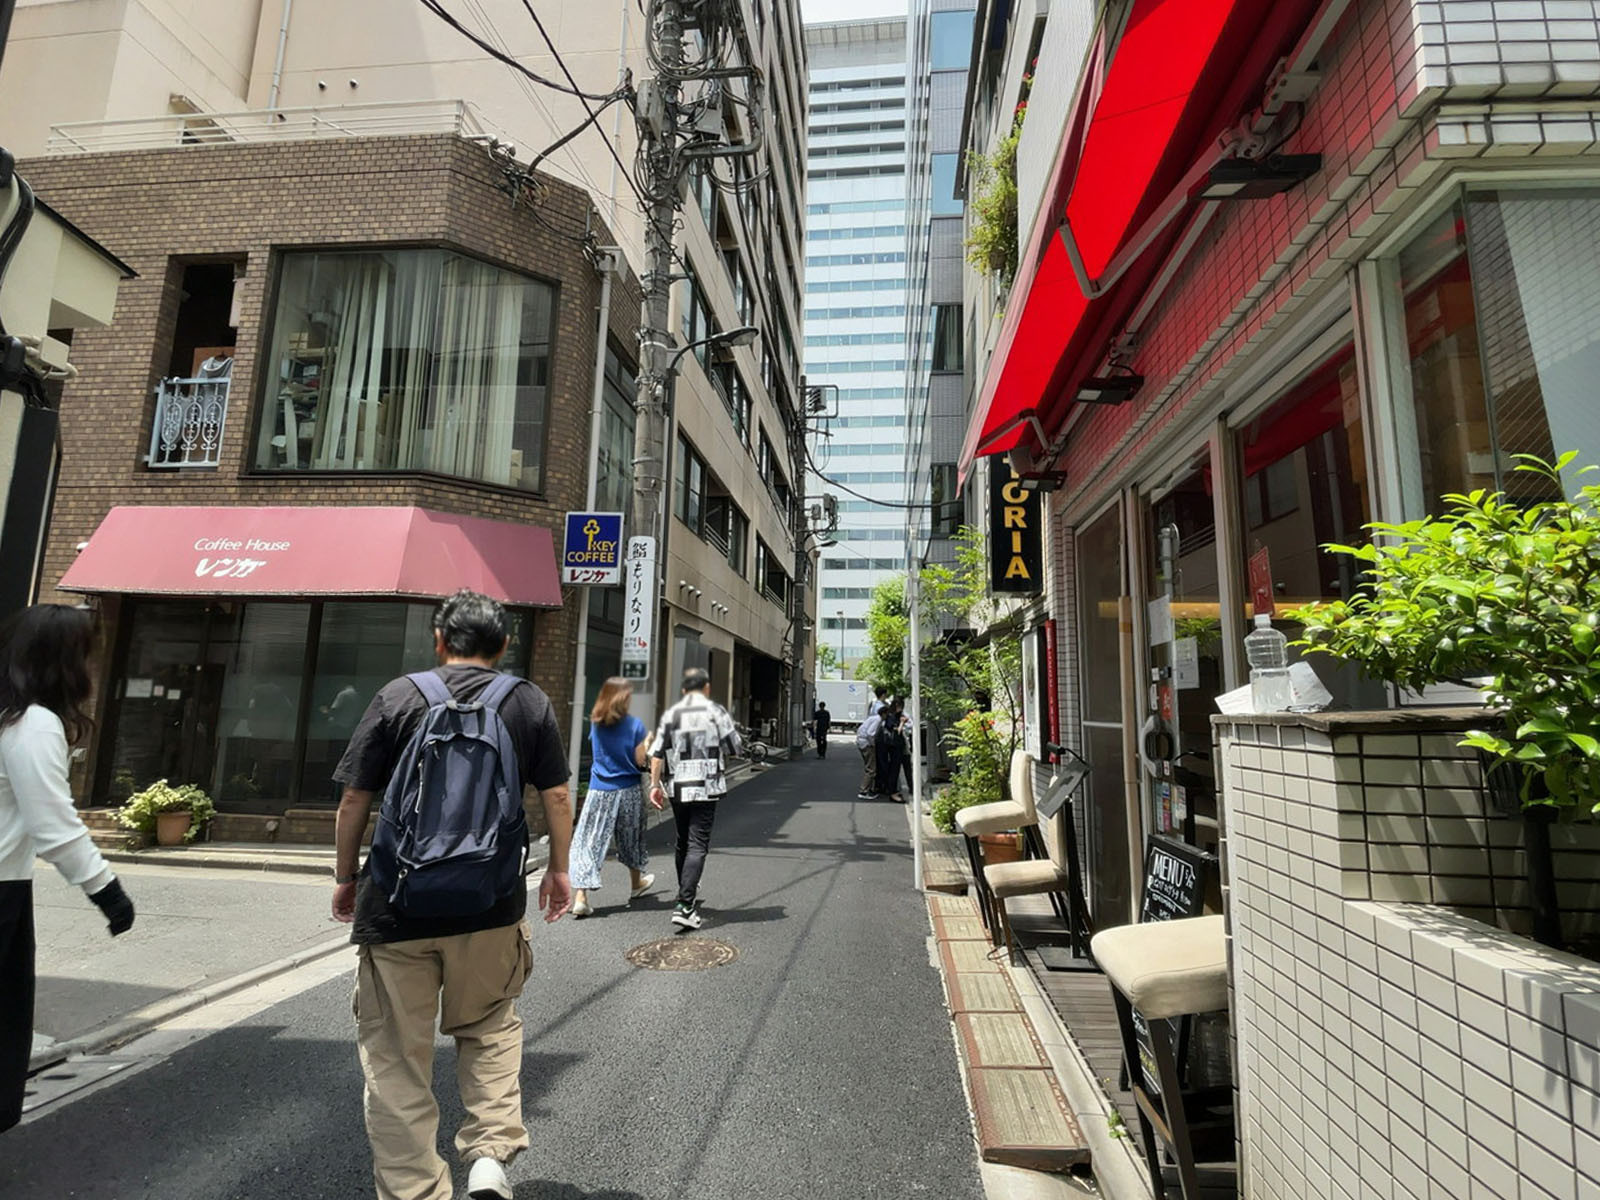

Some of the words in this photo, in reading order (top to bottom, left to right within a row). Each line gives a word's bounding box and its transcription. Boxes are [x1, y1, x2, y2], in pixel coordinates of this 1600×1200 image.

[194, 538, 242, 551] Coffee
[245, 539, 290, 551] House
[592, 541, 617, 551] KEY
[567, 551, 615, 563] COFFEE
[195, 558, 267, 578] レンガ
[570, 569, 611, 583] レンガ
[1153, 853, 1185, 888] MENU
